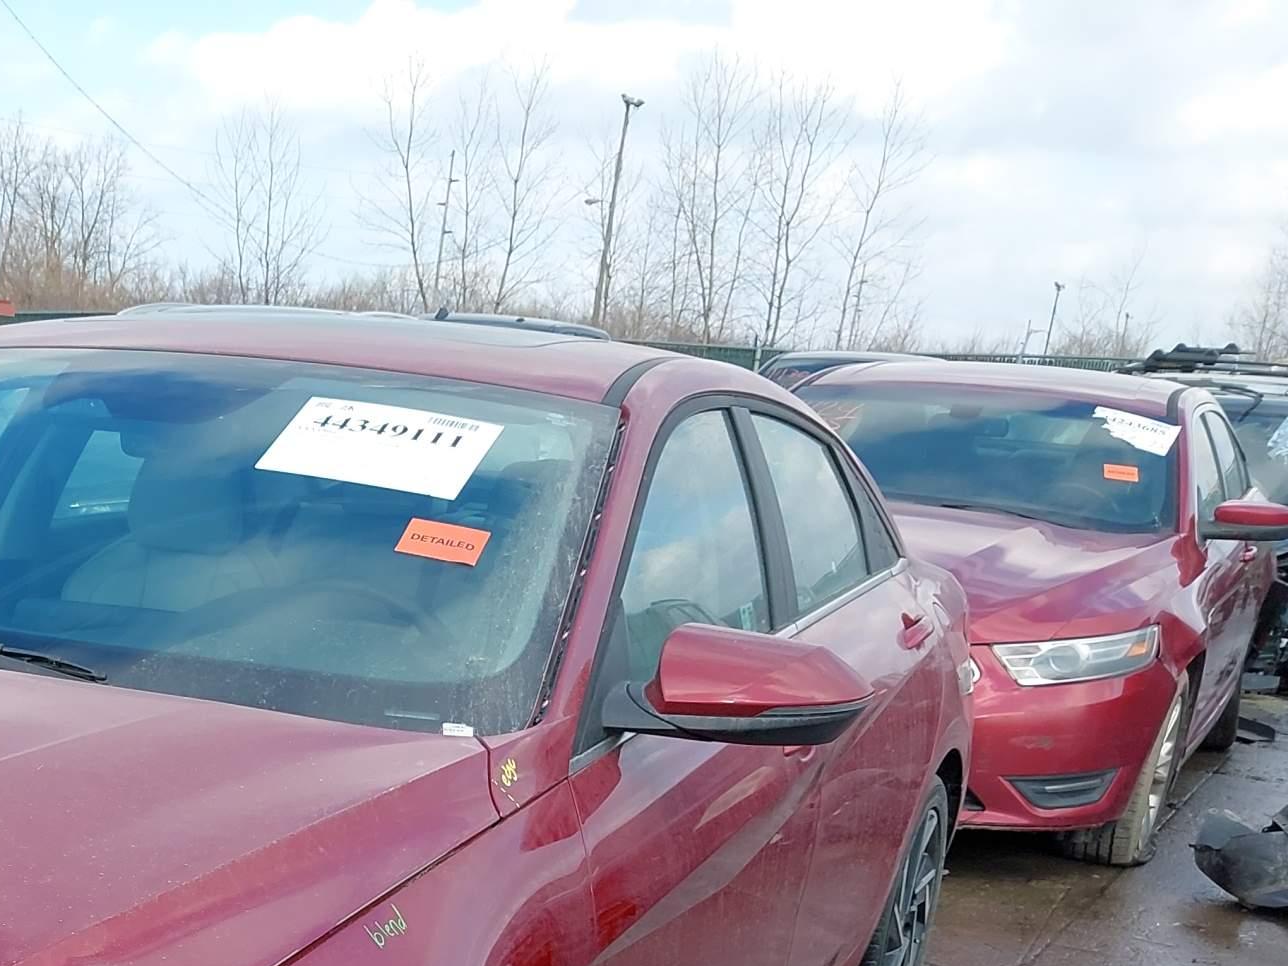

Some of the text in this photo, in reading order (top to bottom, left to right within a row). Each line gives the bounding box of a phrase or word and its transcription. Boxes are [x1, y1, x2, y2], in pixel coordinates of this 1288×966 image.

[313, 415, 464, 448] 44349111
[410, 531, 475, 552] DETAILED
[363, 903, 408, 950] blend
